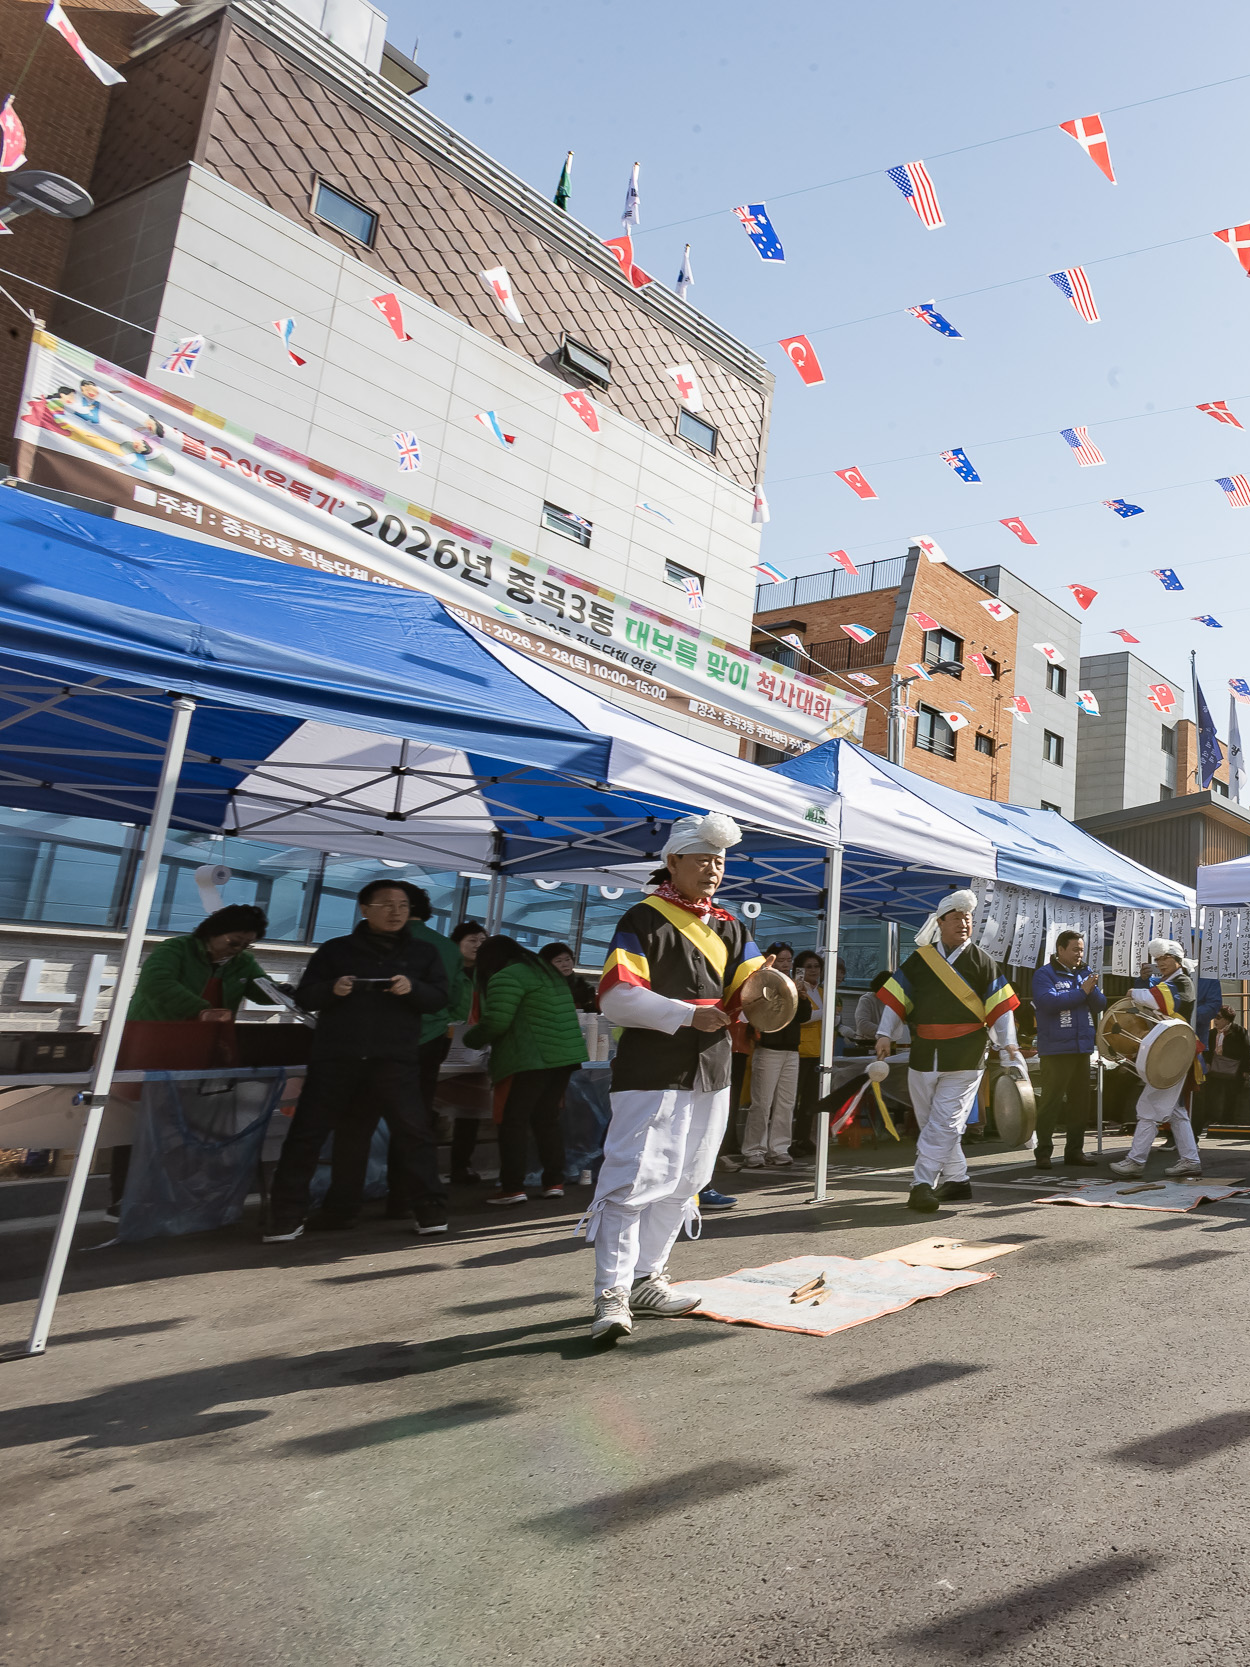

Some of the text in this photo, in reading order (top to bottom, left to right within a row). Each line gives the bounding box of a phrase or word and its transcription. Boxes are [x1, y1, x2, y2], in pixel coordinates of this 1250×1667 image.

[157, 490, 204, 525] 주최
[220, 515, 296, 557] 중곡3동
[352, 500, 493, 588] 2026년
[506, 566, 615, 637] 중곡3동
[625, 616, 698, 671] 대보름
[707, 650, 750, 691] 맞이
[756, 671, 832, 722] 척사대회
[592, 663, 668, 702] 10:00~15:00
[698, 702, 717, 720] 장소
[723, 711, 757, 735] 중곡3동
[756, 725, 789, 747] 주민센터
